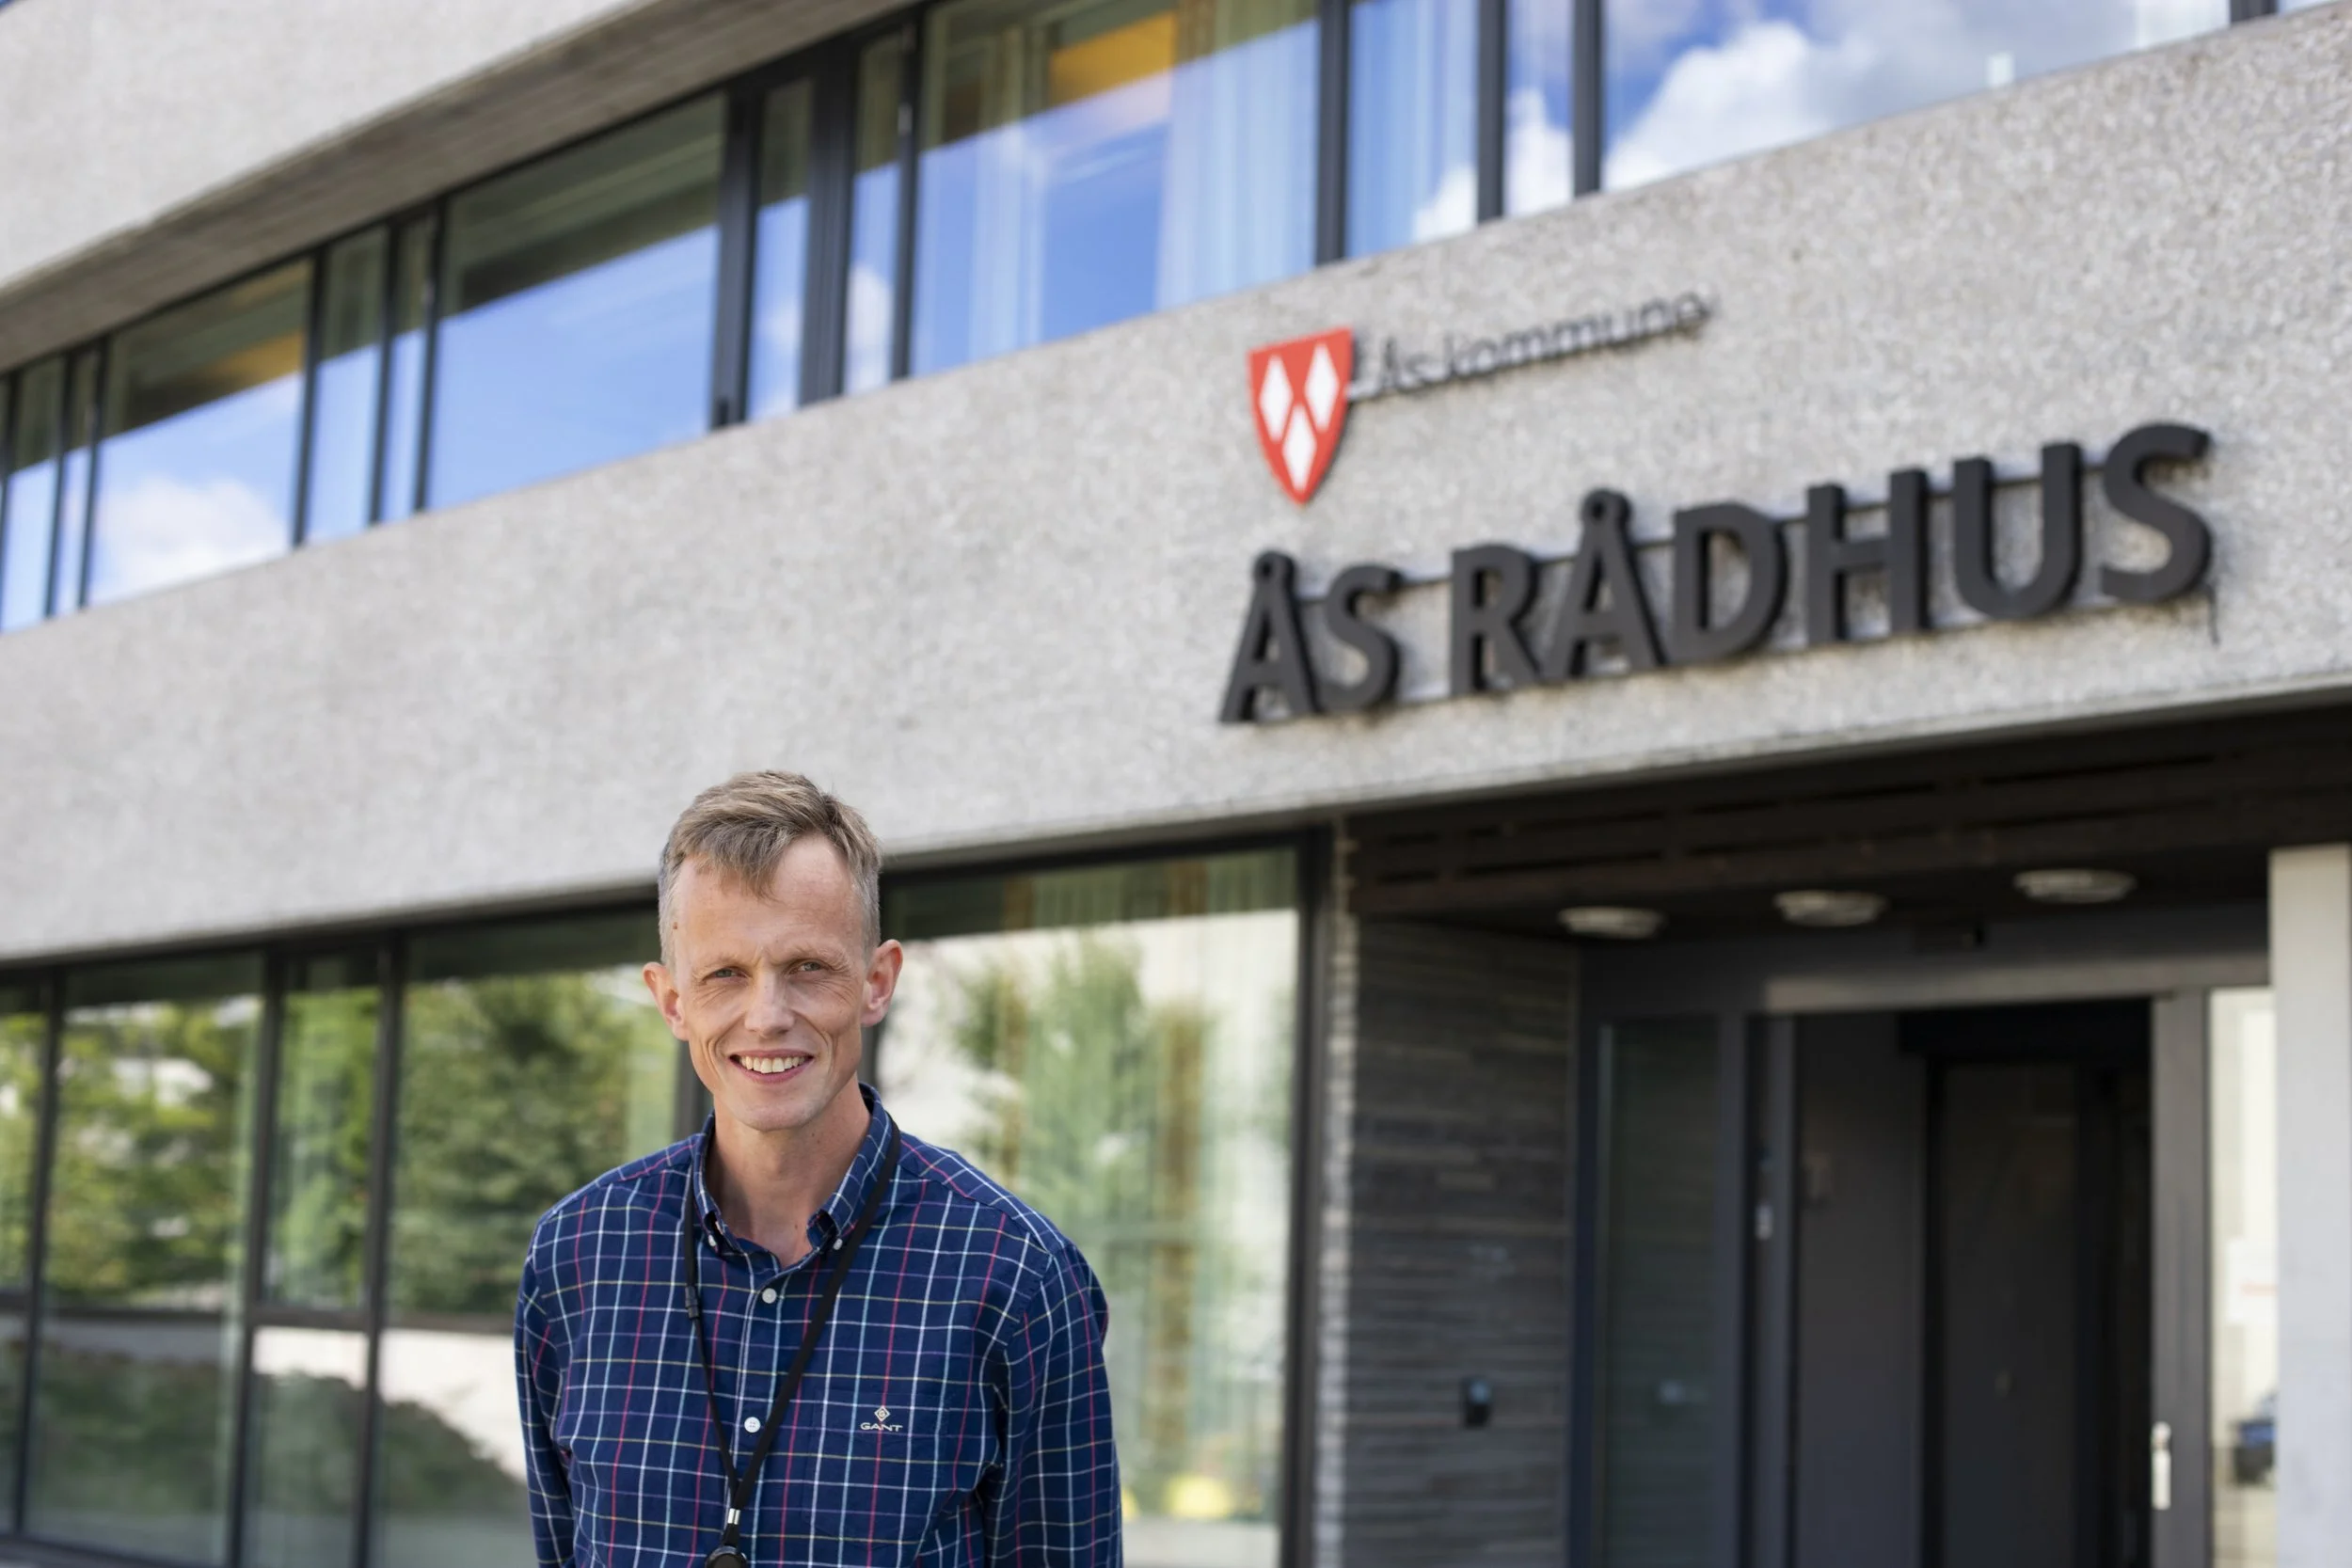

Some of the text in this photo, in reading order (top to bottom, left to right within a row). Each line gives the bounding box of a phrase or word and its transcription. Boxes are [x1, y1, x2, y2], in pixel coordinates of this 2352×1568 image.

[1441, 291, 1712, 378] kommune
[1219, 421, 2214, 724] ÅS RÅDHUS
[860, 1422, 903, 1432] GANT
